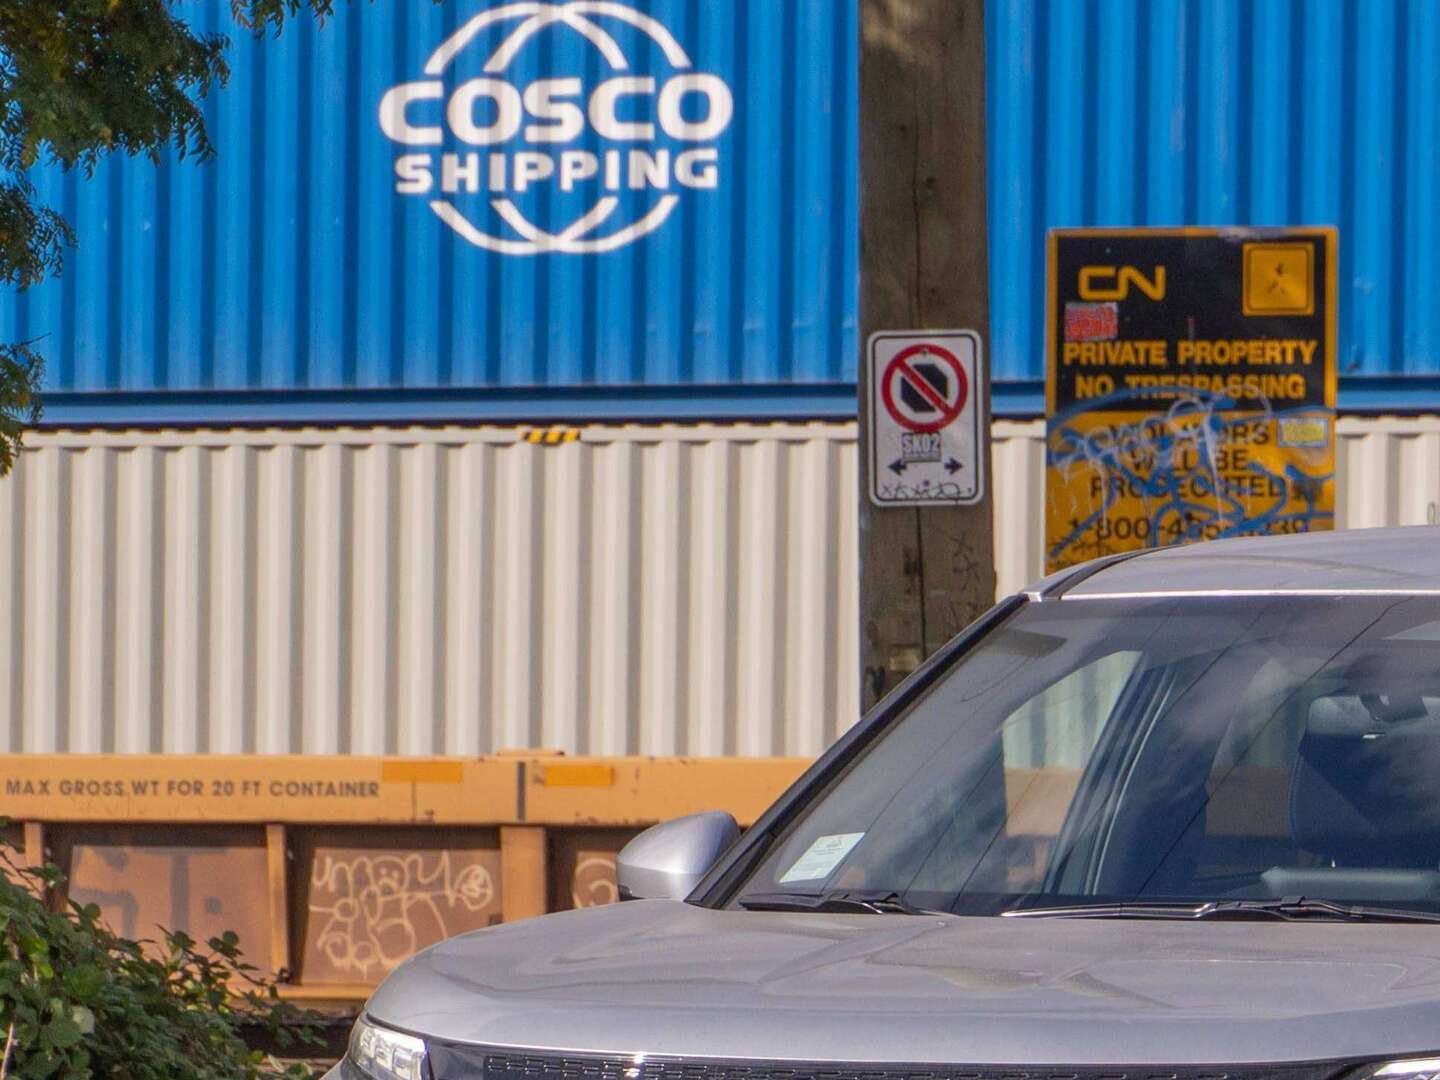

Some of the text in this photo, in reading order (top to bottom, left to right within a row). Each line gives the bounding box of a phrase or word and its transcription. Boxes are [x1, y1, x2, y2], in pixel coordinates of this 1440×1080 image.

[379, 73, 733, 146] COSCO
[395, 149, 718, 194] SHIPPING
[1078, 265, 1166, 301] CN
[1063, 340, 1318, 366] PRIVATE PROPERTY
[1075, 376, 1115, 399] NO
[6, 779, 380, 797] MAX GROSS WT FOR 20 FT CONTAINER
